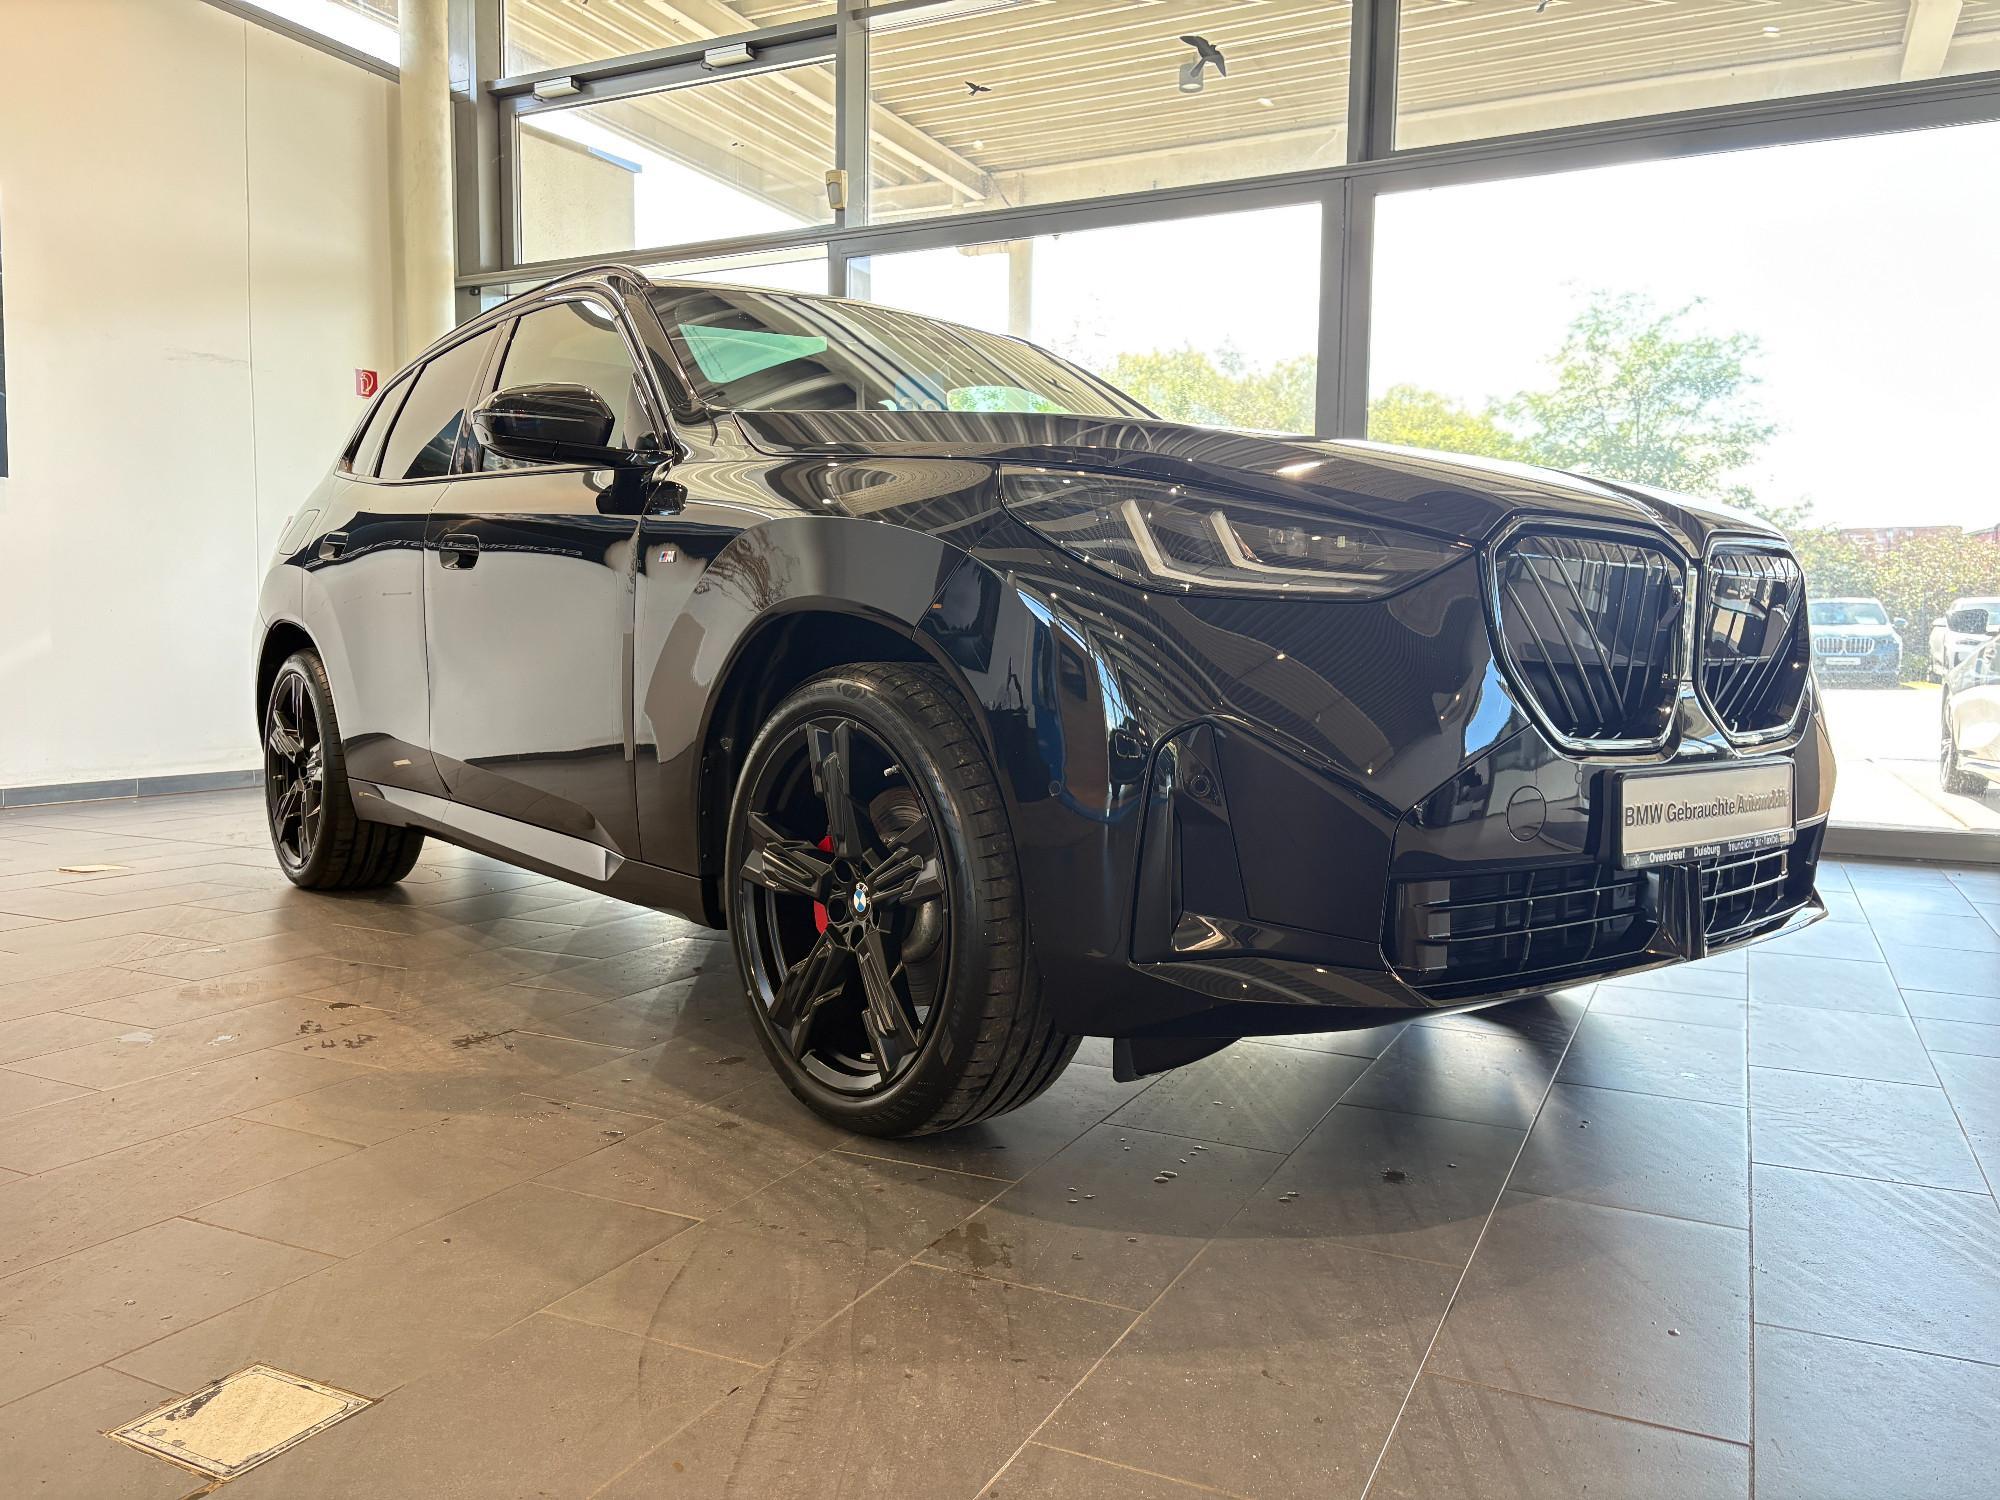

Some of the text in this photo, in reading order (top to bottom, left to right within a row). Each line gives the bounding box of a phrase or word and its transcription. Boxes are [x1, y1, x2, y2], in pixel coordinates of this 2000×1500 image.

[1624, 803, 1663, 827] BMW
[1667, 797, 1735, 822] Gebrauchte
[1693, 844, 1721, 857] Duisburg
